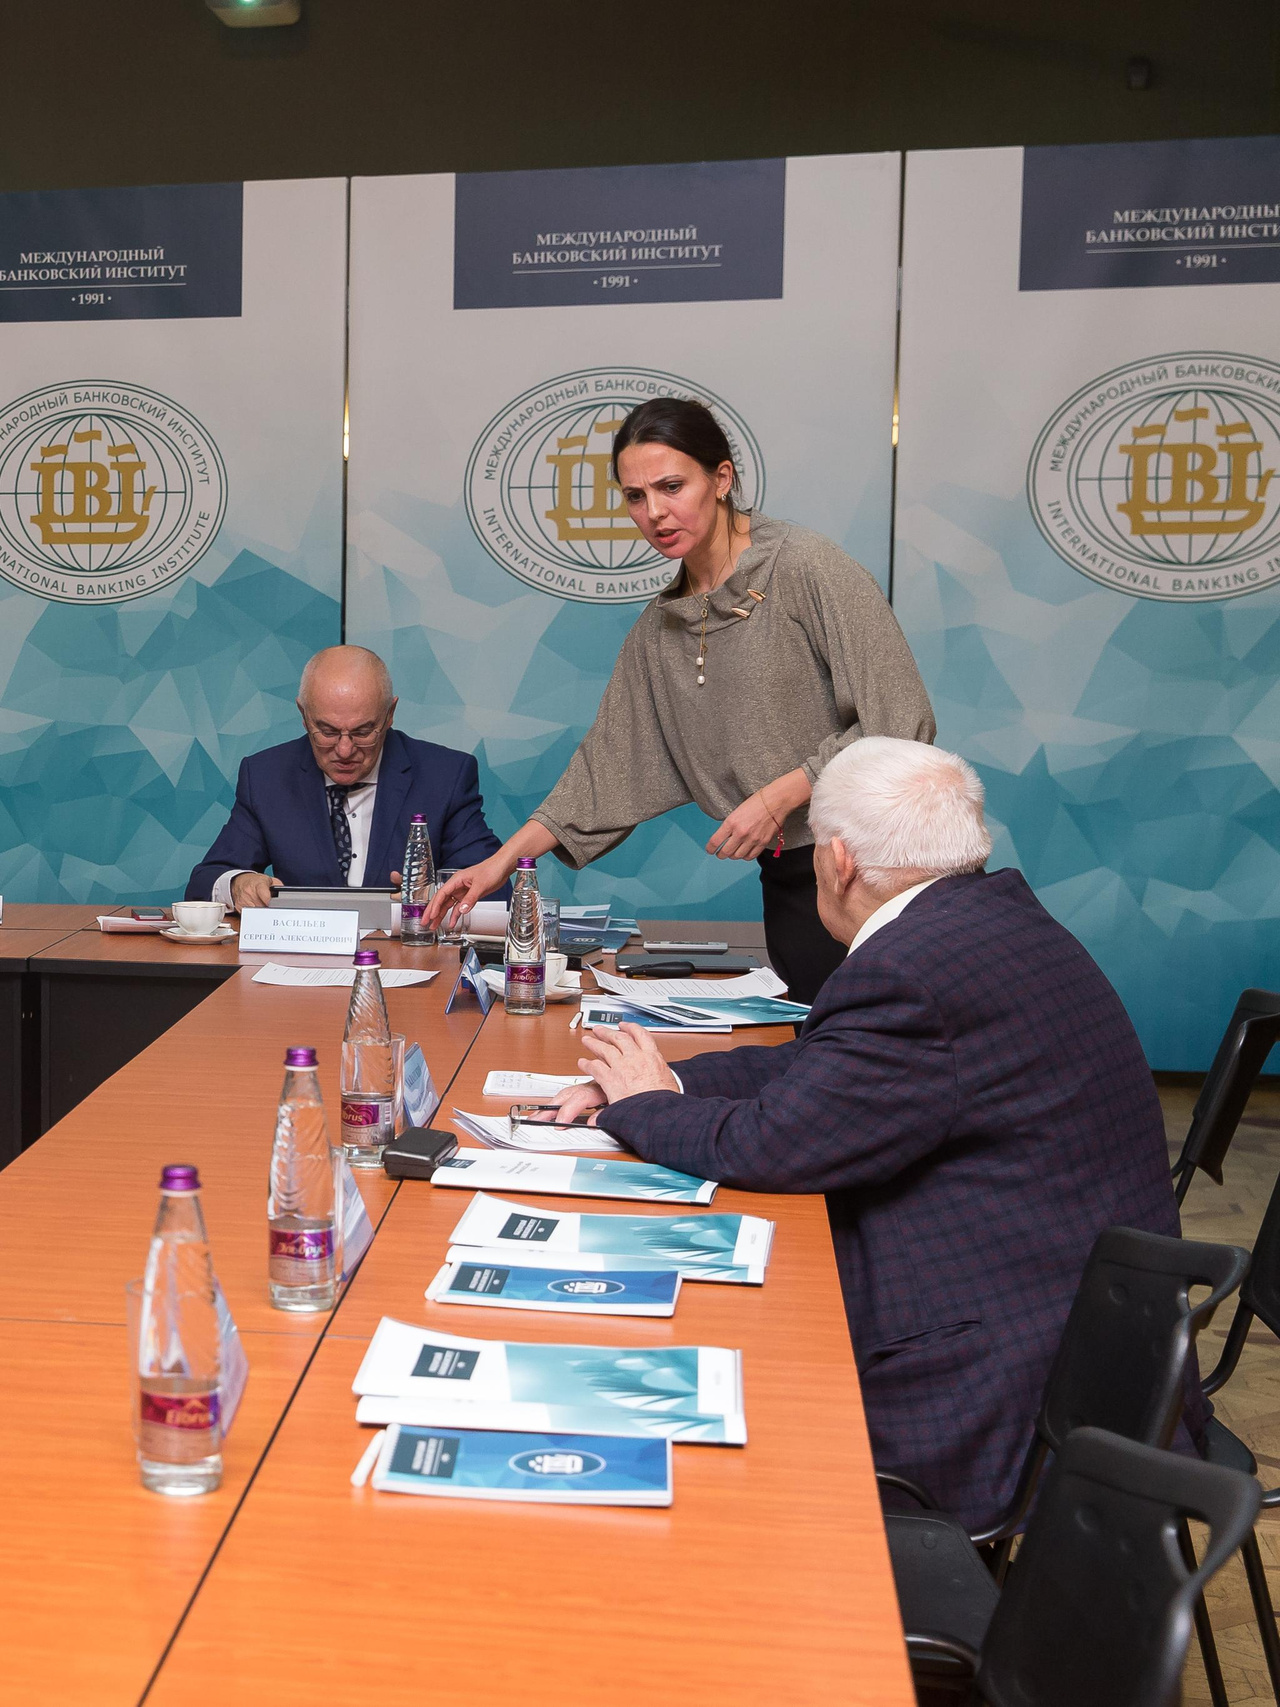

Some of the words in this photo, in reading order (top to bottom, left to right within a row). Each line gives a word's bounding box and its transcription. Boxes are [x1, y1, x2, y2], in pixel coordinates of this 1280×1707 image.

[536, 224, 698, 247] МЕЖДУНАРОДНЫЙ
[1084, 223, 1215, 244] БАНКОВСКИЙ
[20, 245, 165, 265] МЕЖДУНАРОДНЫЙ
[512, 245, 627, 265] БАНКОВСКИЙ
[631, 244, 723, 261] ИНСТИТУТ
[106, 264, 188, 280] ИНСТИТУТ
[1049, 366, 1169, 473] МЕЖДУНАРОДНЫЙ
[1175, 363, 1280, 394] БАНКОВСКИ
[73, 391, 168, 422] БАНКОВСКИЙ
[167, 417, 210, 485] ИНСТИТУТ
[484, 380, 590, 481] МЕЖДУНАРОДНЫЙ
[76, 574, 147, 596] BANKING
[151, 510, 211, 579] INSTITUTE
[482, 507, 586, 592] INTERNATIONAL
[595, 571, 673, 594] BANKING
[1047, 500, 1161, 590] INTERNATIONAL
[1172, 568, 1260, 592] BANKING
[272, 919, 326, 928] ВАСИЛЬЕВ
[243, 933, 276, 941] СЕРГЕЙ
